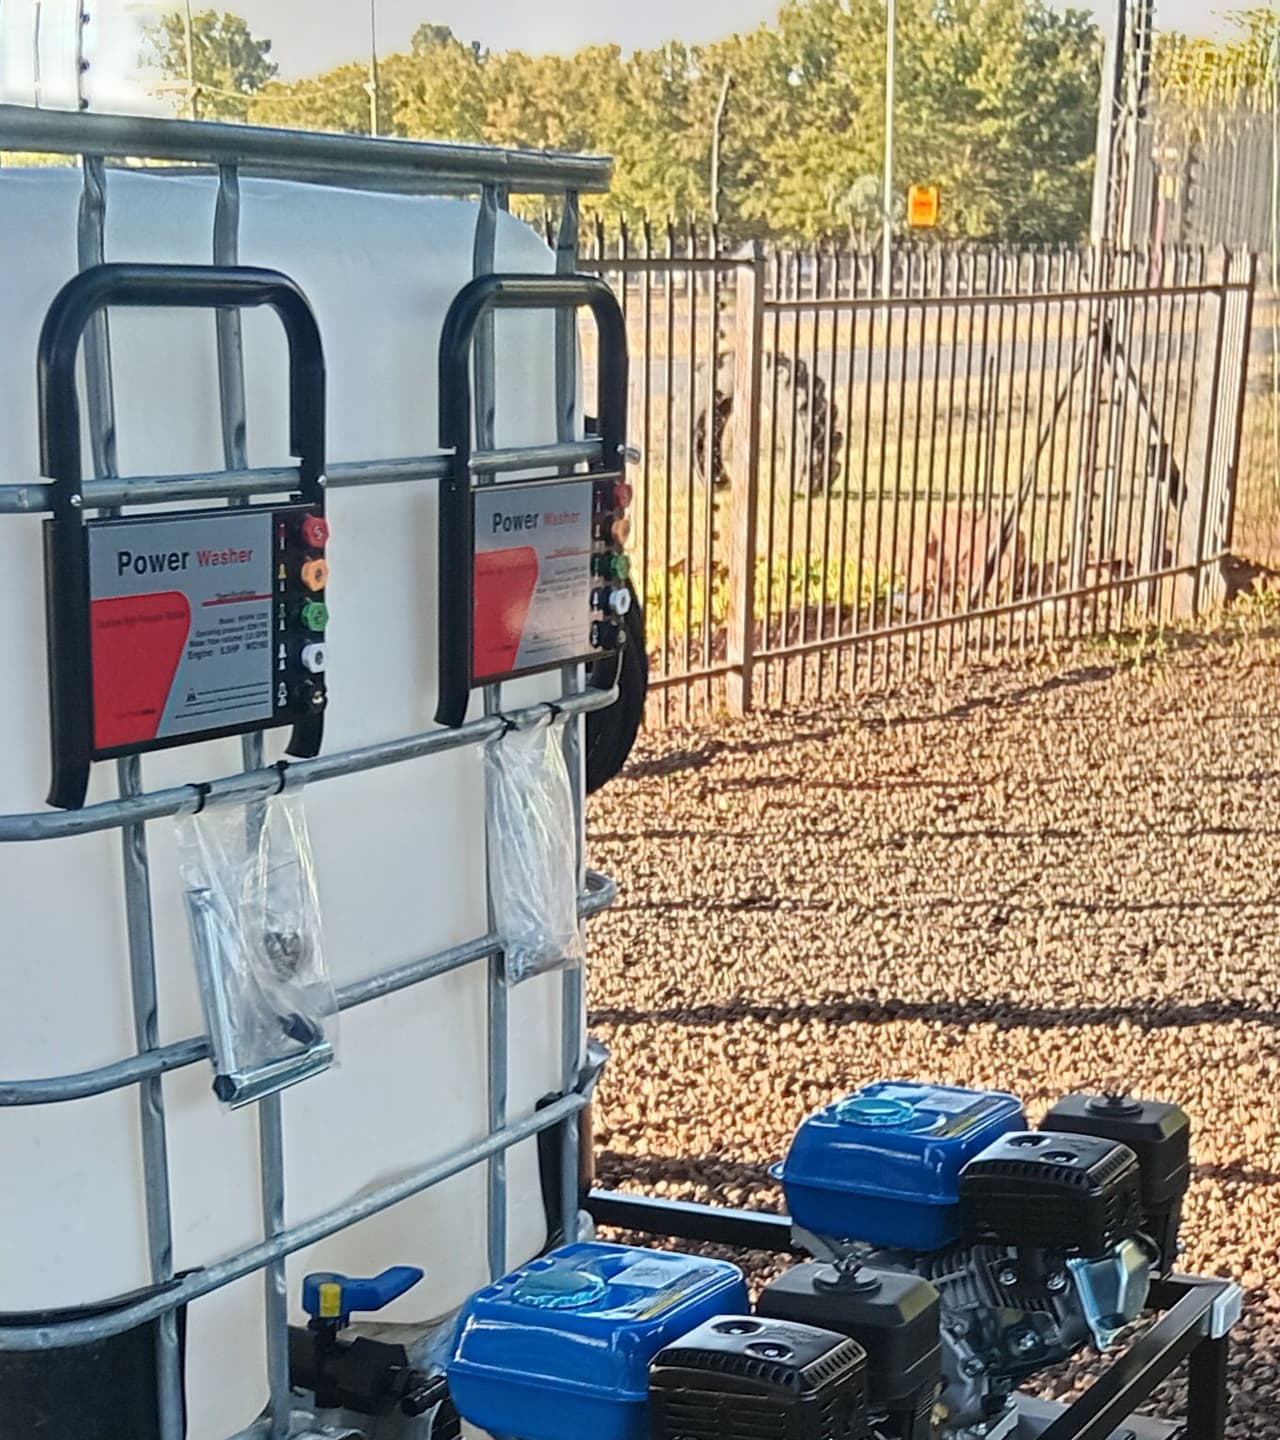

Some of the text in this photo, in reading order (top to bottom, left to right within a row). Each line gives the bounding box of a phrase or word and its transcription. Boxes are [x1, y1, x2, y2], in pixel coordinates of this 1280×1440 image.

[492, 512, 539, 533] Power
[117, 548, 253, 576] Power Washer
